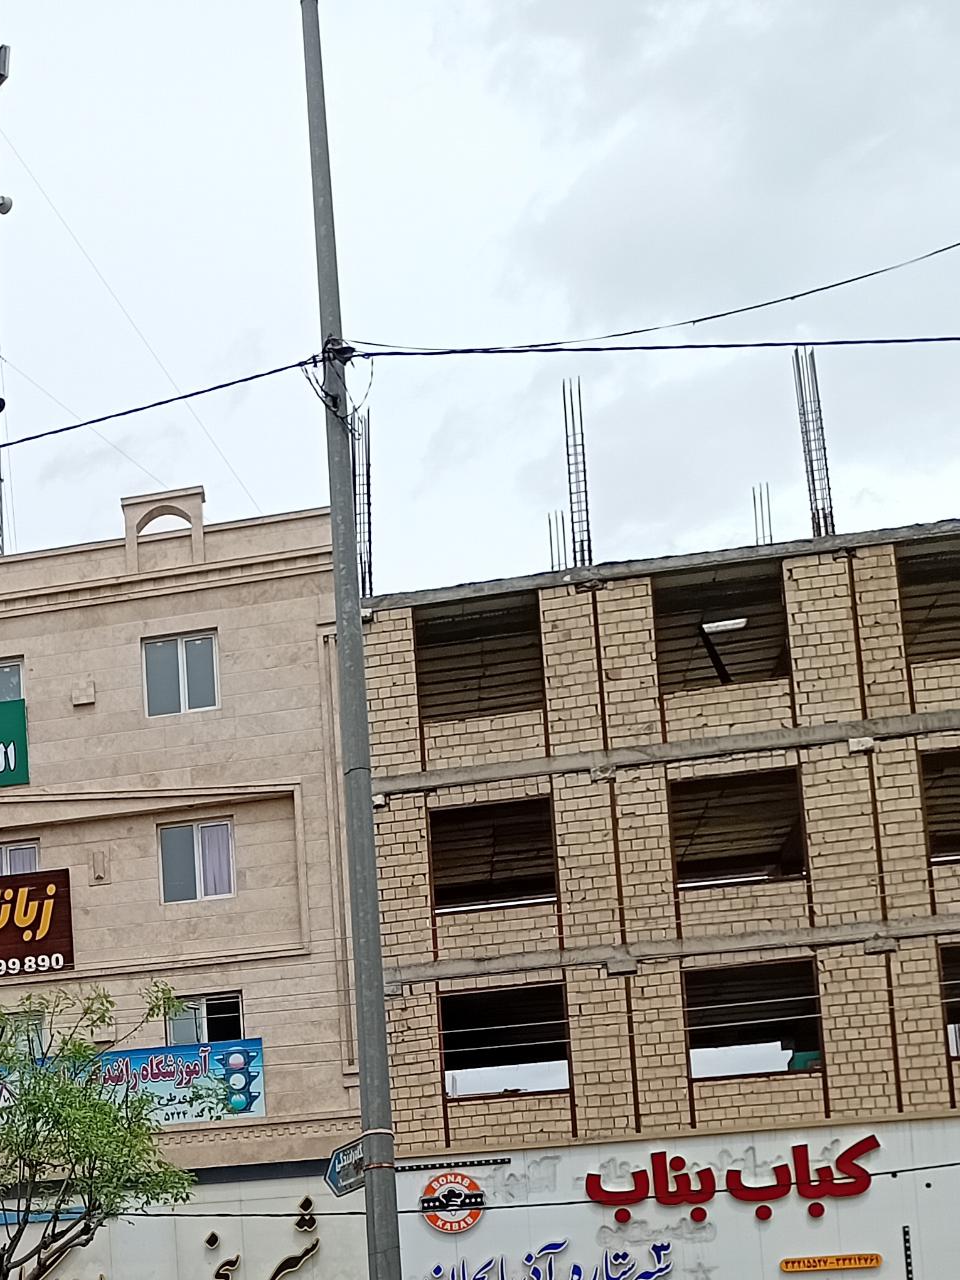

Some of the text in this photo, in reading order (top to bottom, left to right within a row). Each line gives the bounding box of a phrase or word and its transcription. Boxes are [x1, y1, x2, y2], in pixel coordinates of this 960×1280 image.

[85, 1046, 213, 1093] آموزشگاه رانند
[431, 1174, 471, 1190] BONAB
[584, 1150, 717, 1224] بناب
[725, 1133, 882, 1222] کباب
[436, 1216, 474, 1231] KABAB
